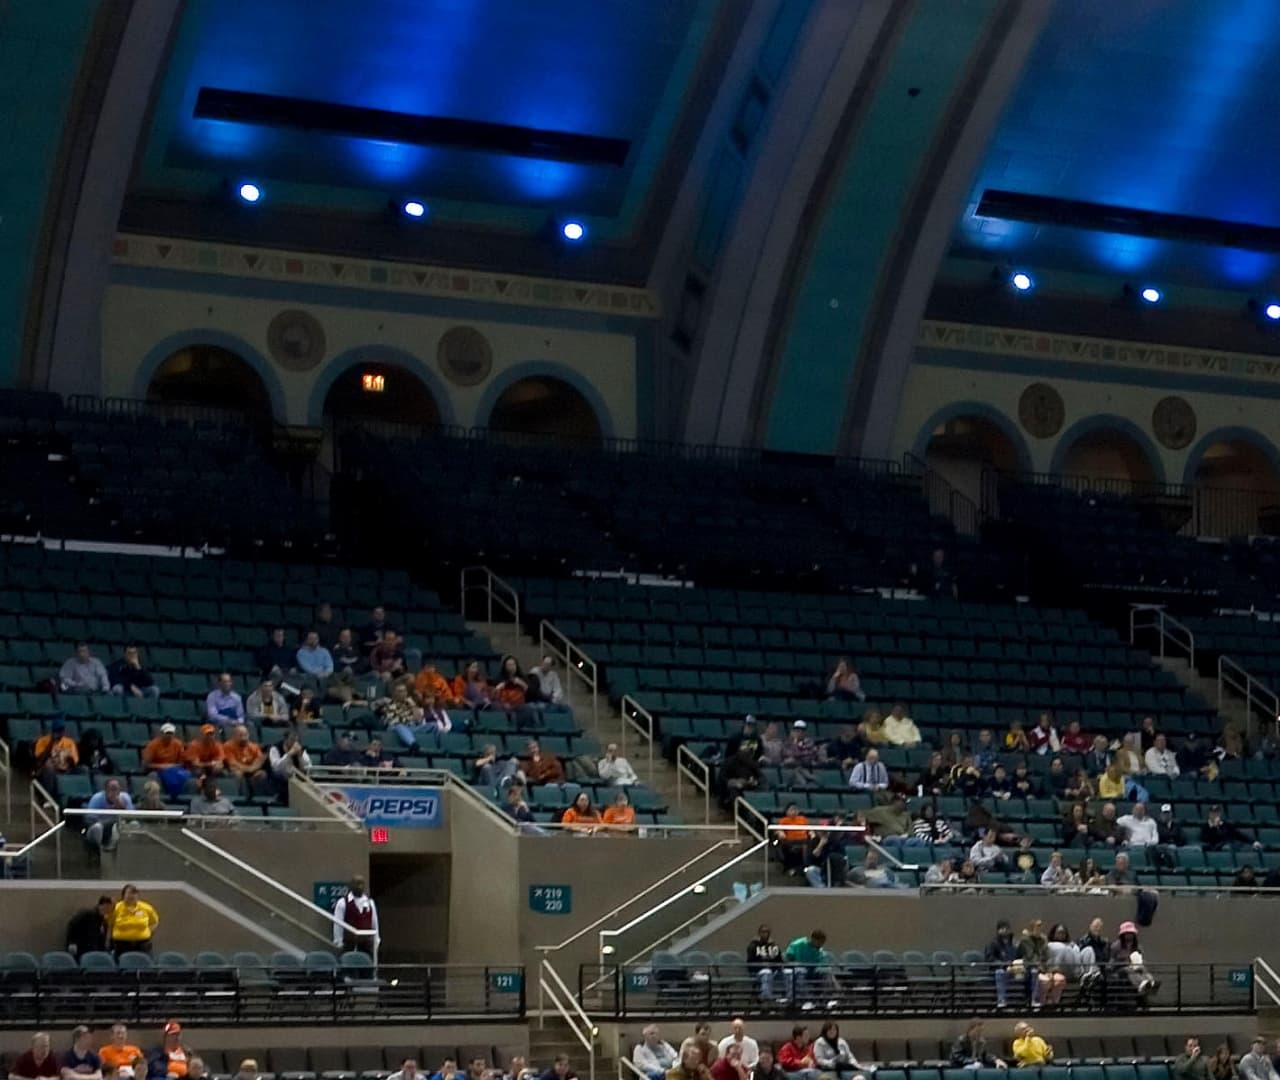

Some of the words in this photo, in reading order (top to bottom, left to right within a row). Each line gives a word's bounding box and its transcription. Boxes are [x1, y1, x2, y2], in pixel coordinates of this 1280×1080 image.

[367, 799, 435, 816] PEPSI
[544, 889, 562, 899] 219
[544, 901, 562, 911] 220
[496, 975, 513, 986] 121
[632, 975, 650, 986] 120
